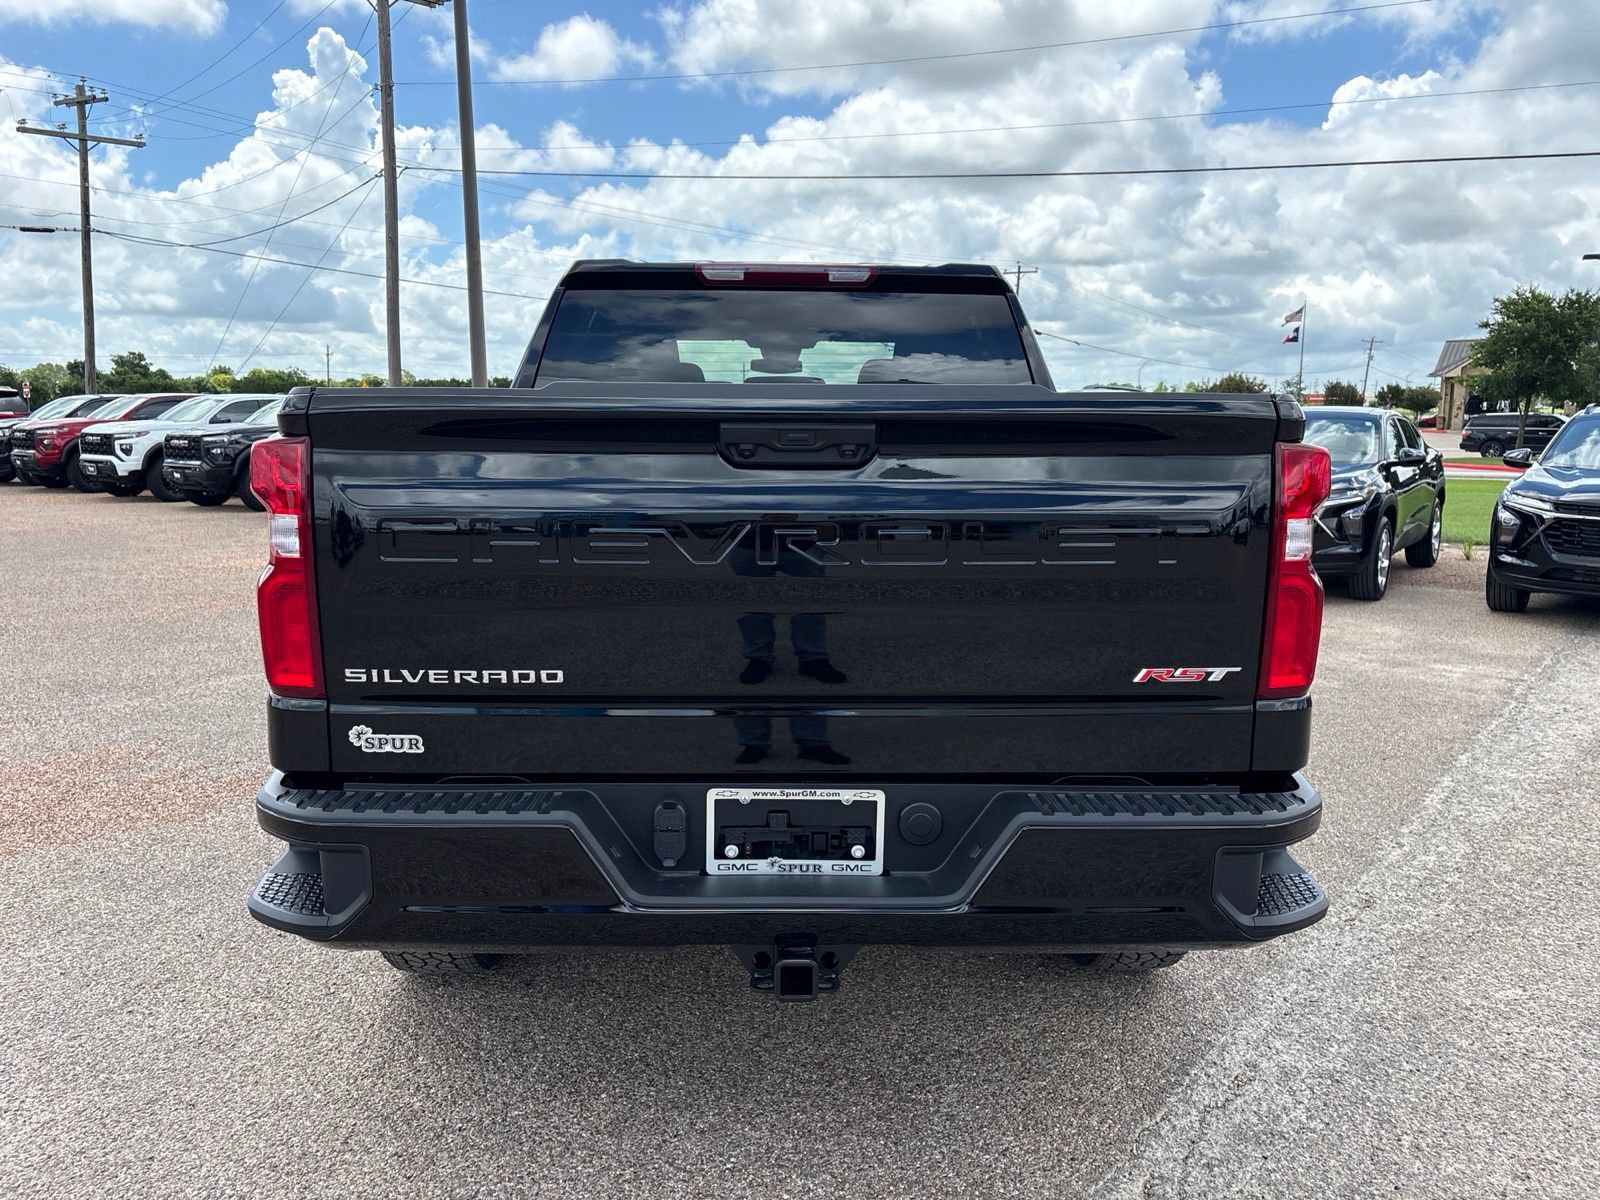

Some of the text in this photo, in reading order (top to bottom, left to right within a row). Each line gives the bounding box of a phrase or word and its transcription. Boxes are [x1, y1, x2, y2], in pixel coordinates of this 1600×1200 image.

[376, 517, 1211, 566] CHEVROLET
[344, 668, 564, 684] SILVERADO
[1133, 667, 1242, 682] RST
[364, 737, 421, 750] SPUR
[752, 789, 841, 798] www.SpurGM.com
[717, 863, 873, 873] GMC SPUR GMC
